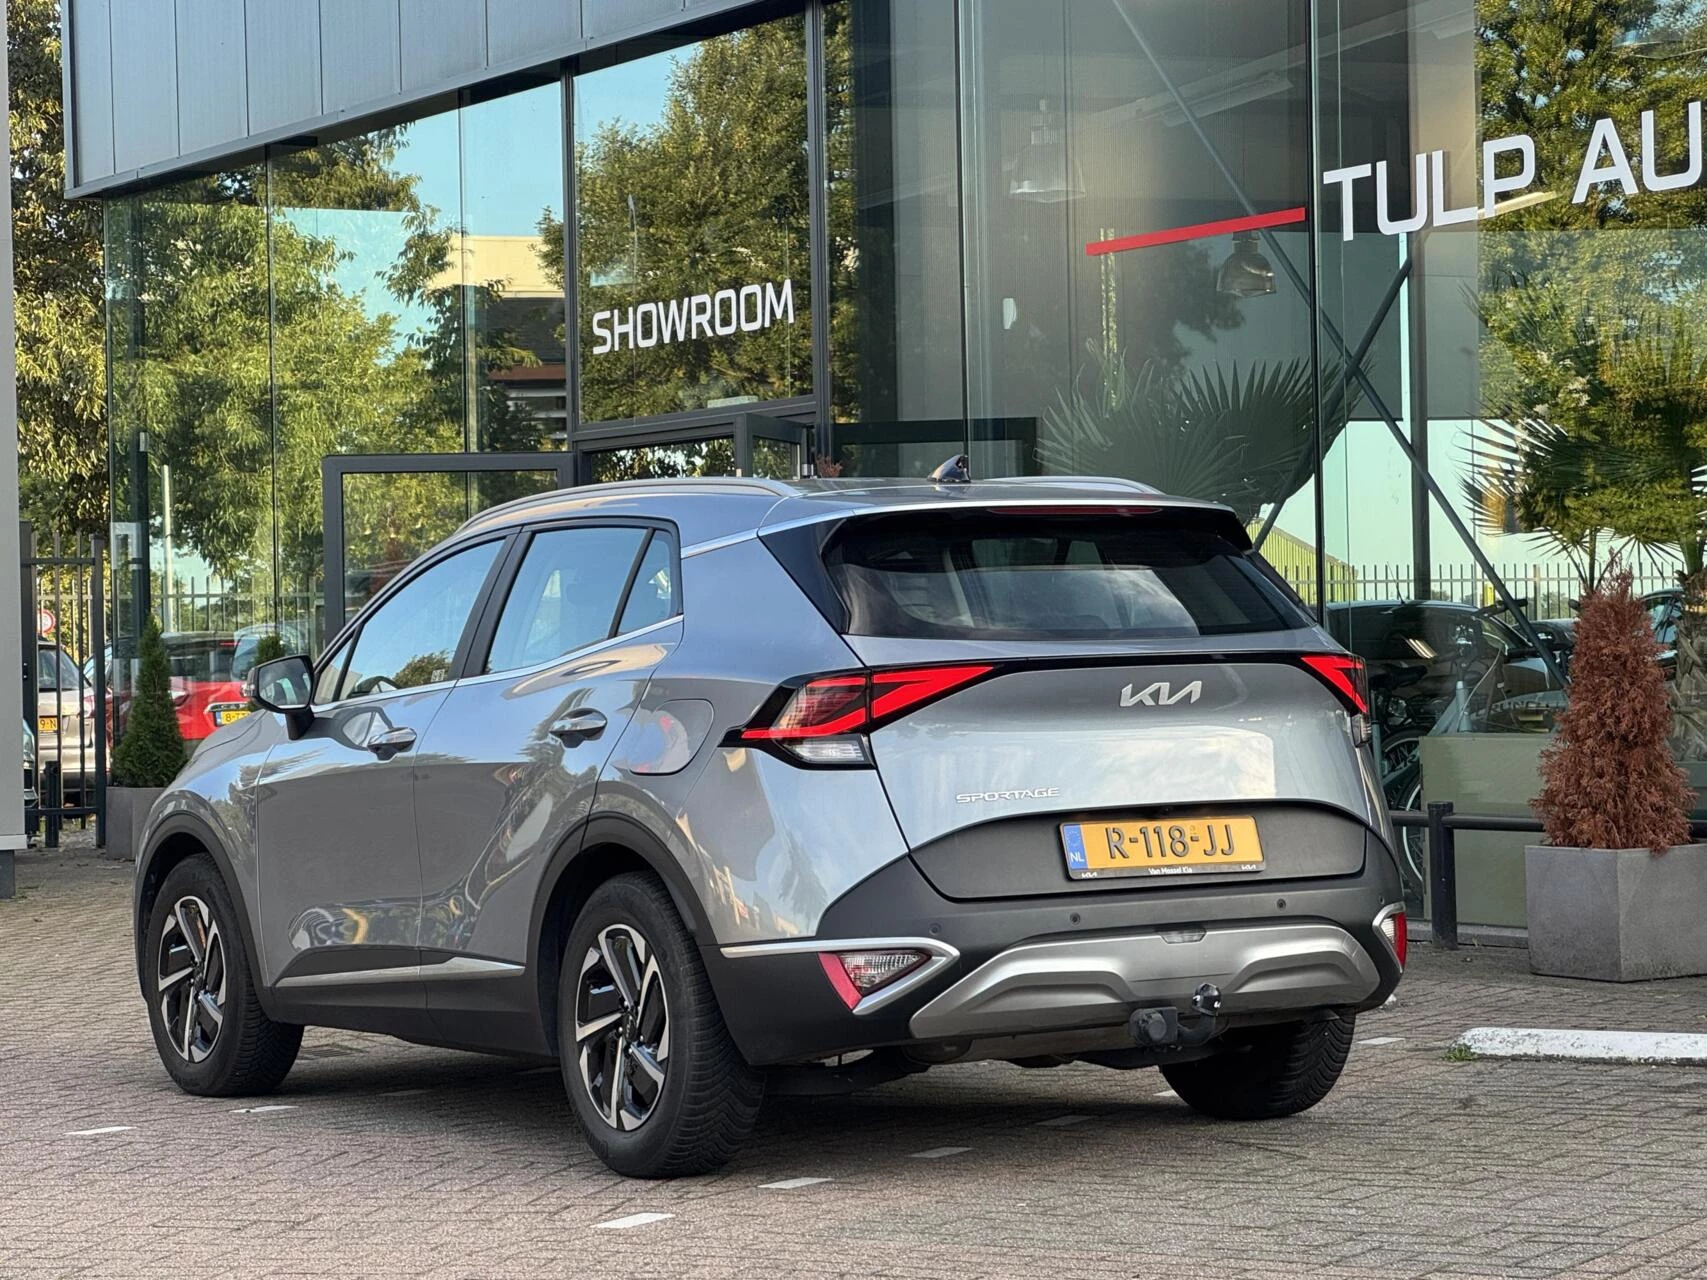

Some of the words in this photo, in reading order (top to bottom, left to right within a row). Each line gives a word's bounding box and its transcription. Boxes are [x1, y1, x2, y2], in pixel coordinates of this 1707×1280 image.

[1323, 134, 1536, 242] TULP
[1571, 101, 1702, 204] AU
[592, 278, 795, 355] SHOWROOM
[1119, 680, 1203, 707] KIA
[956, 787, 1060, 803] SPORTAGE
[1105, 824, 1235, 859] R-118-JJ
[1070, 851, 1085, 863] NL
[1148, 867, 1161, 875] Van
[1182, 865, 1193, 874] Kia
